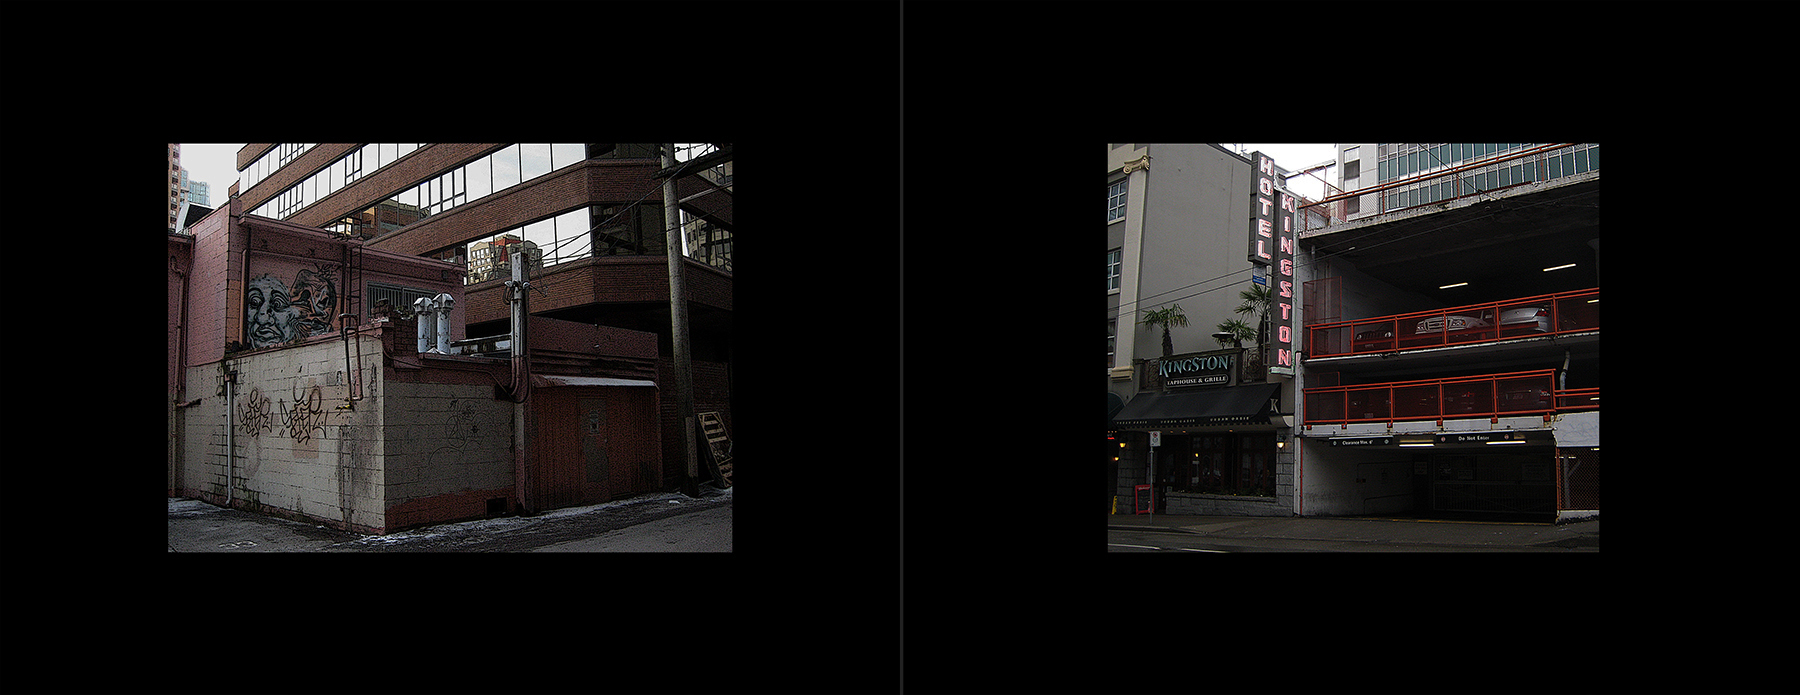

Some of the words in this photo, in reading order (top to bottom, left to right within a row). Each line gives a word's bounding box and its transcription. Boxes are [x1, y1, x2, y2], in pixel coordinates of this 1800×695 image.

[1257, 155, 1274, 260] HOTEL
[1278, 193, 1295, 366] KINGSTON
[1159, 355, 1229, 378] KINGSTON
[1167, 378, 1197, 386] TAPHOUSE
[1204, 375, 1226, 383] GRILLE
[1269, 398, 1280, 414] K
